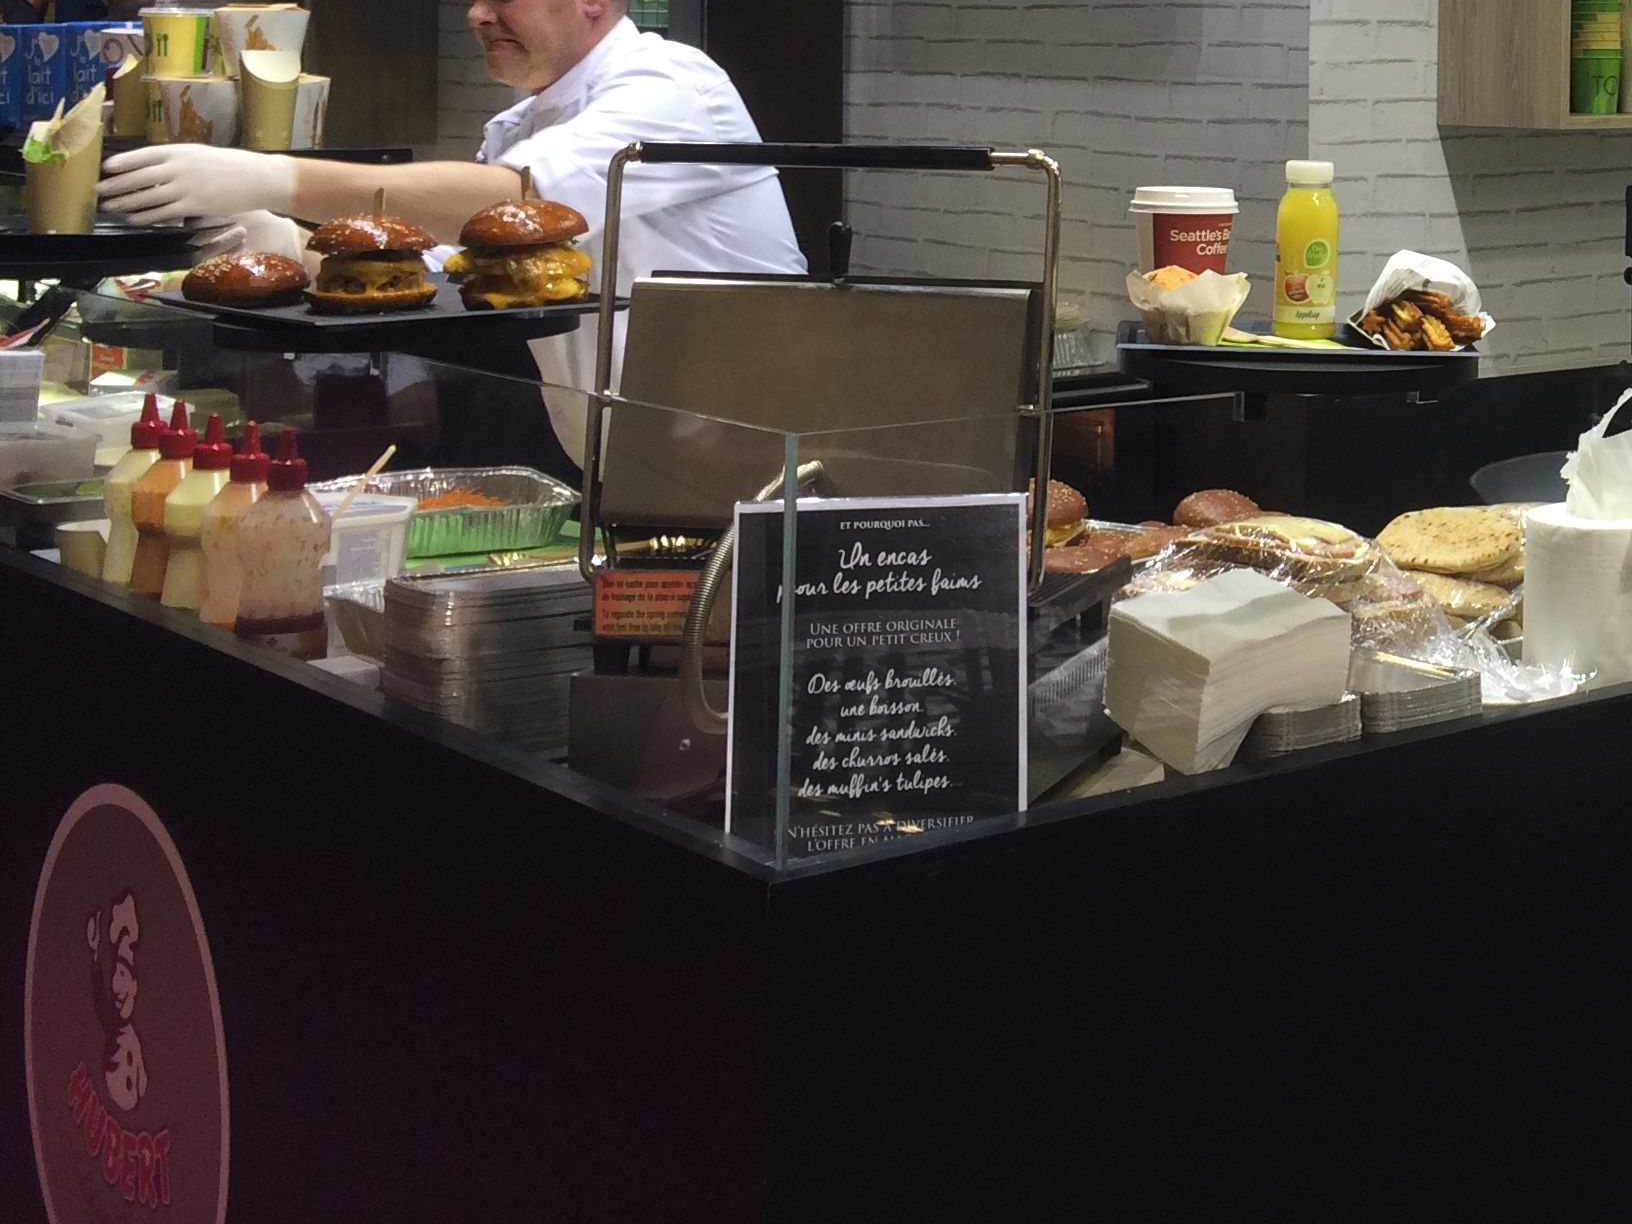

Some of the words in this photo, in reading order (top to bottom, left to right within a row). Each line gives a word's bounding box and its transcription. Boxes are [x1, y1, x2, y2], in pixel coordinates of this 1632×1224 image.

[29, 66, 52, 85] lait
[73, 64, 98, 84] lait
[1170, 228, 1222, 243] Seattle's
[840, 521, 851, 530] ET
[853, 520, 905, 531] POURQUOI
[838, 541, 872, 570] Un
[877, 548, 933, 567] encas
[833, 571, 862, 594] les
[865, 570, 927, 599] petites
[931, 567, 983, 595] faims
[810, 622, 839, 635] UNE
[842, 621, 882, 634] OFFRE
[886, 618, 957, 632] ORIGINALE
[806, 636, 843, 649] POUR
[847, 635, 867, 647] UN
[872, 633, 906, 646] PETIT
[910, 631, 952, 643] CREUX
[807, 673, 841, 694] Des
[840, 704, 866, 717] une
[806, 725, 831, 745] des
[835, 728, 877, 743] minis
[812, 750, 839, 770] des
[842, 746, 902, 767] churros
[798, 777, 824, 797] des
[827, 773, 892, 798] muffin's
[858, 822, 879, 834] PAS
[67, 1061, 171, 1209] HUBERT
